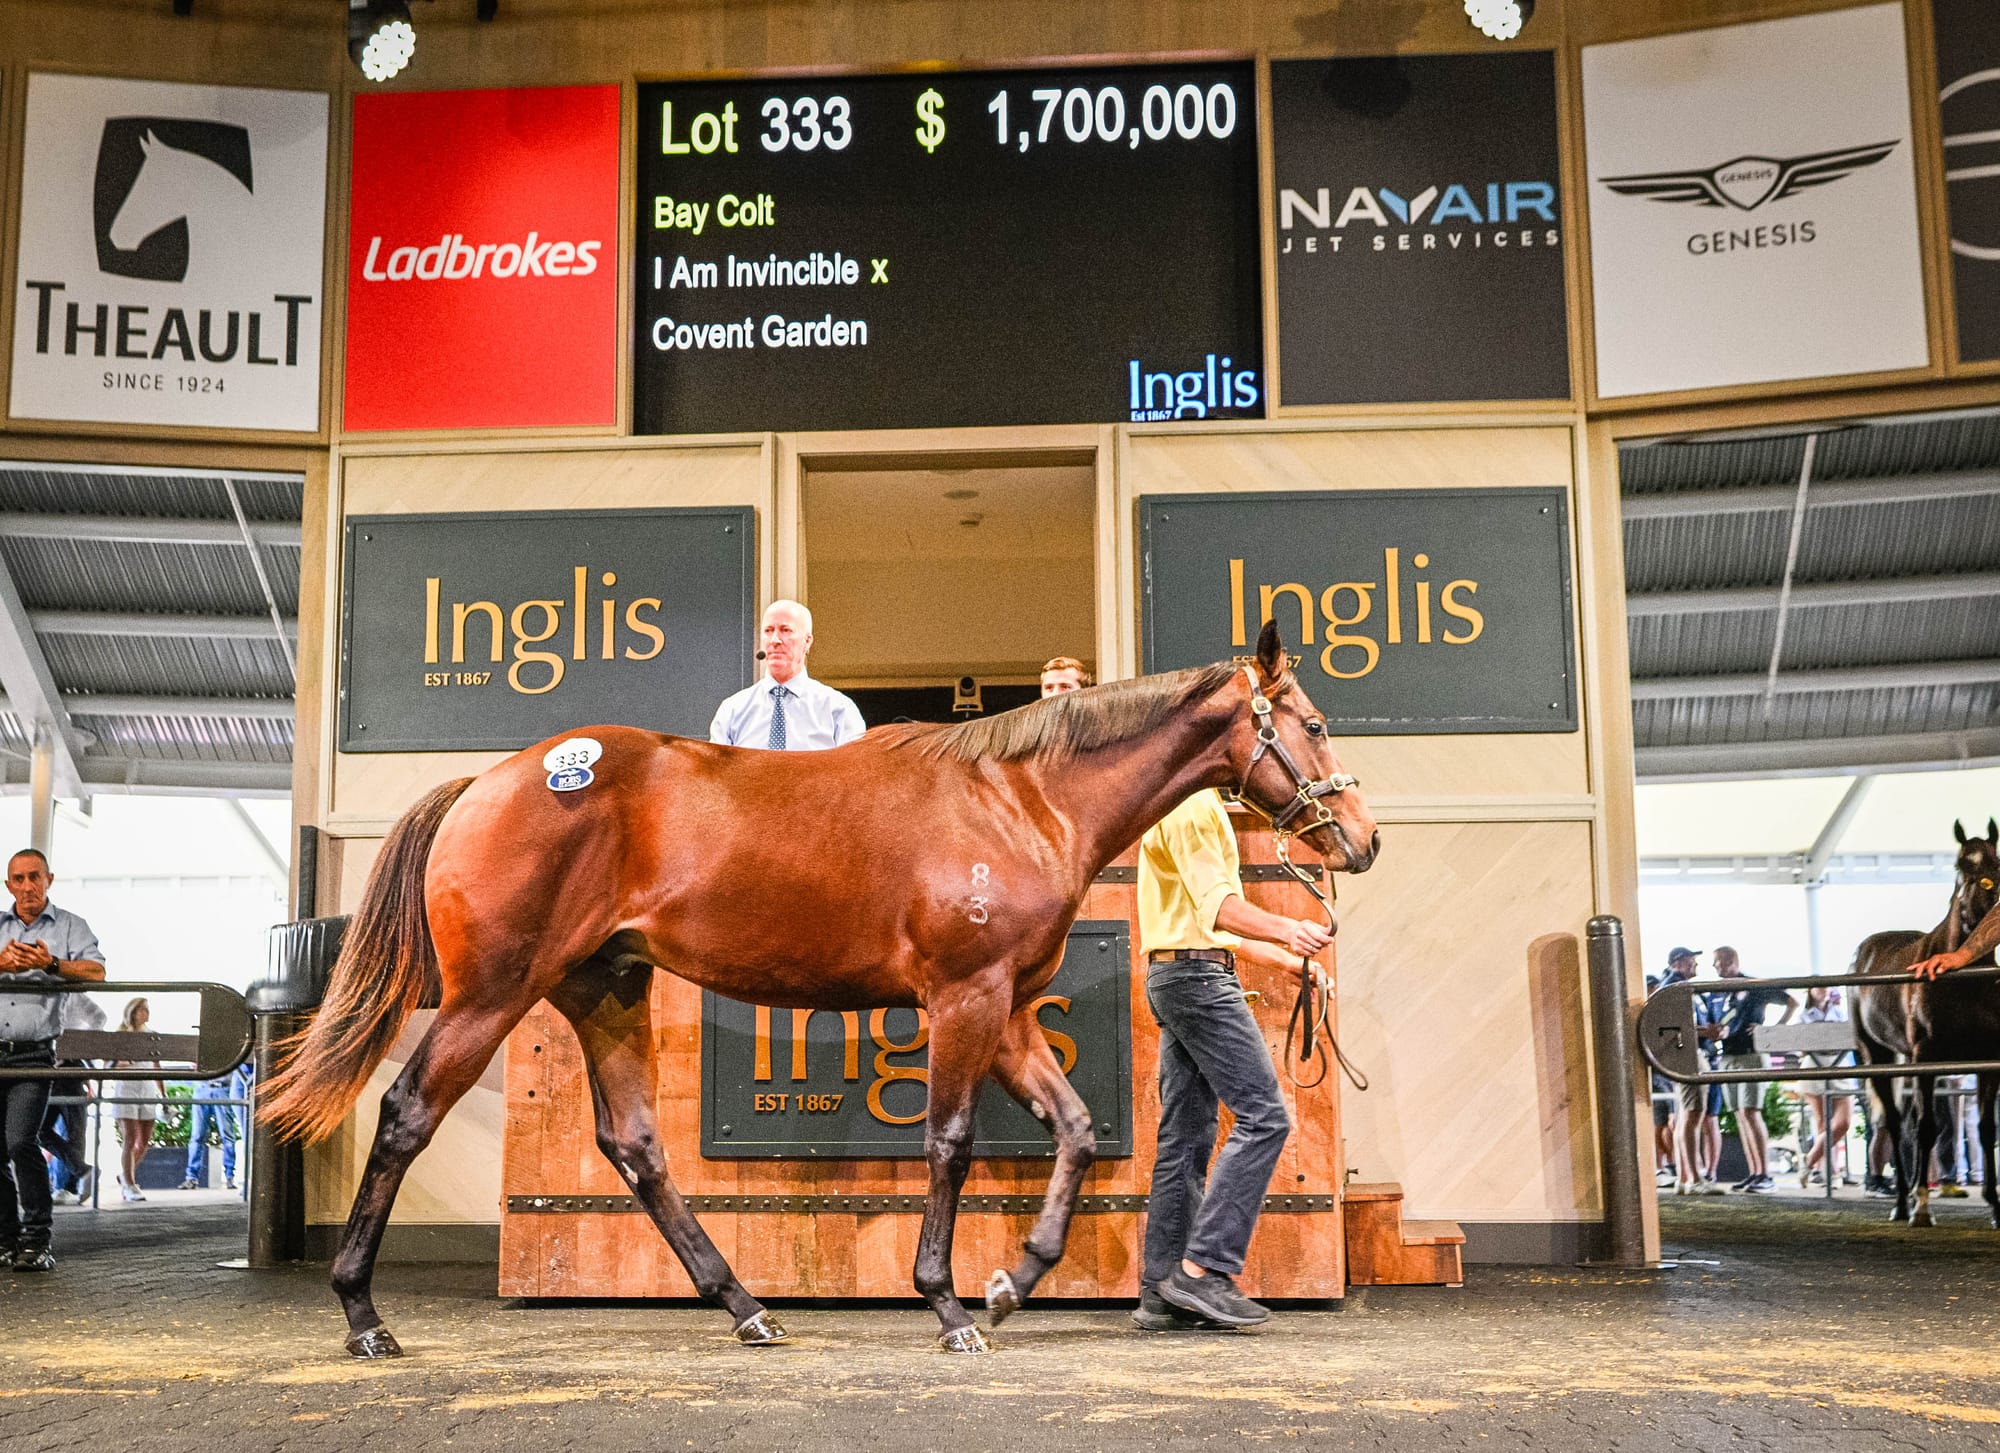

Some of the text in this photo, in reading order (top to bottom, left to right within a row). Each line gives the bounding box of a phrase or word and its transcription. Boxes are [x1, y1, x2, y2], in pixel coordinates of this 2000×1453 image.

[661, 83, 1237, 154] Lot 333 $ 1,700,000
[654, 194, 775, 234] Bay Colt
[1281, 230, 1560, 255] JET SERVICES
[1687, 221, 1818, 256] GENESIS
[363, 232, 602, 282] Ladbrokes
[653, 253, 889, 289] I Am Invincible x
[26, 280, 313, 367] THEAULT
[652, 314, 868, 350] Covent Garden
[102, 371, 226, 394] SINCE 1924
[1129, 353, 1258, 420] Inglis
[1130, 410, 1172, 422] Est 1867
[424, 566, 666, 694] Inglis
[1229, 547, 1485, 679] Inglis
[424, 672, 491, 687] EST 1867
[555, 750, 589, 769] 333
[971, 863, 990, 887] 8
[753, 995, 1078, 1125] Ings
[754, 1094, 843, 1112] EST 1867
